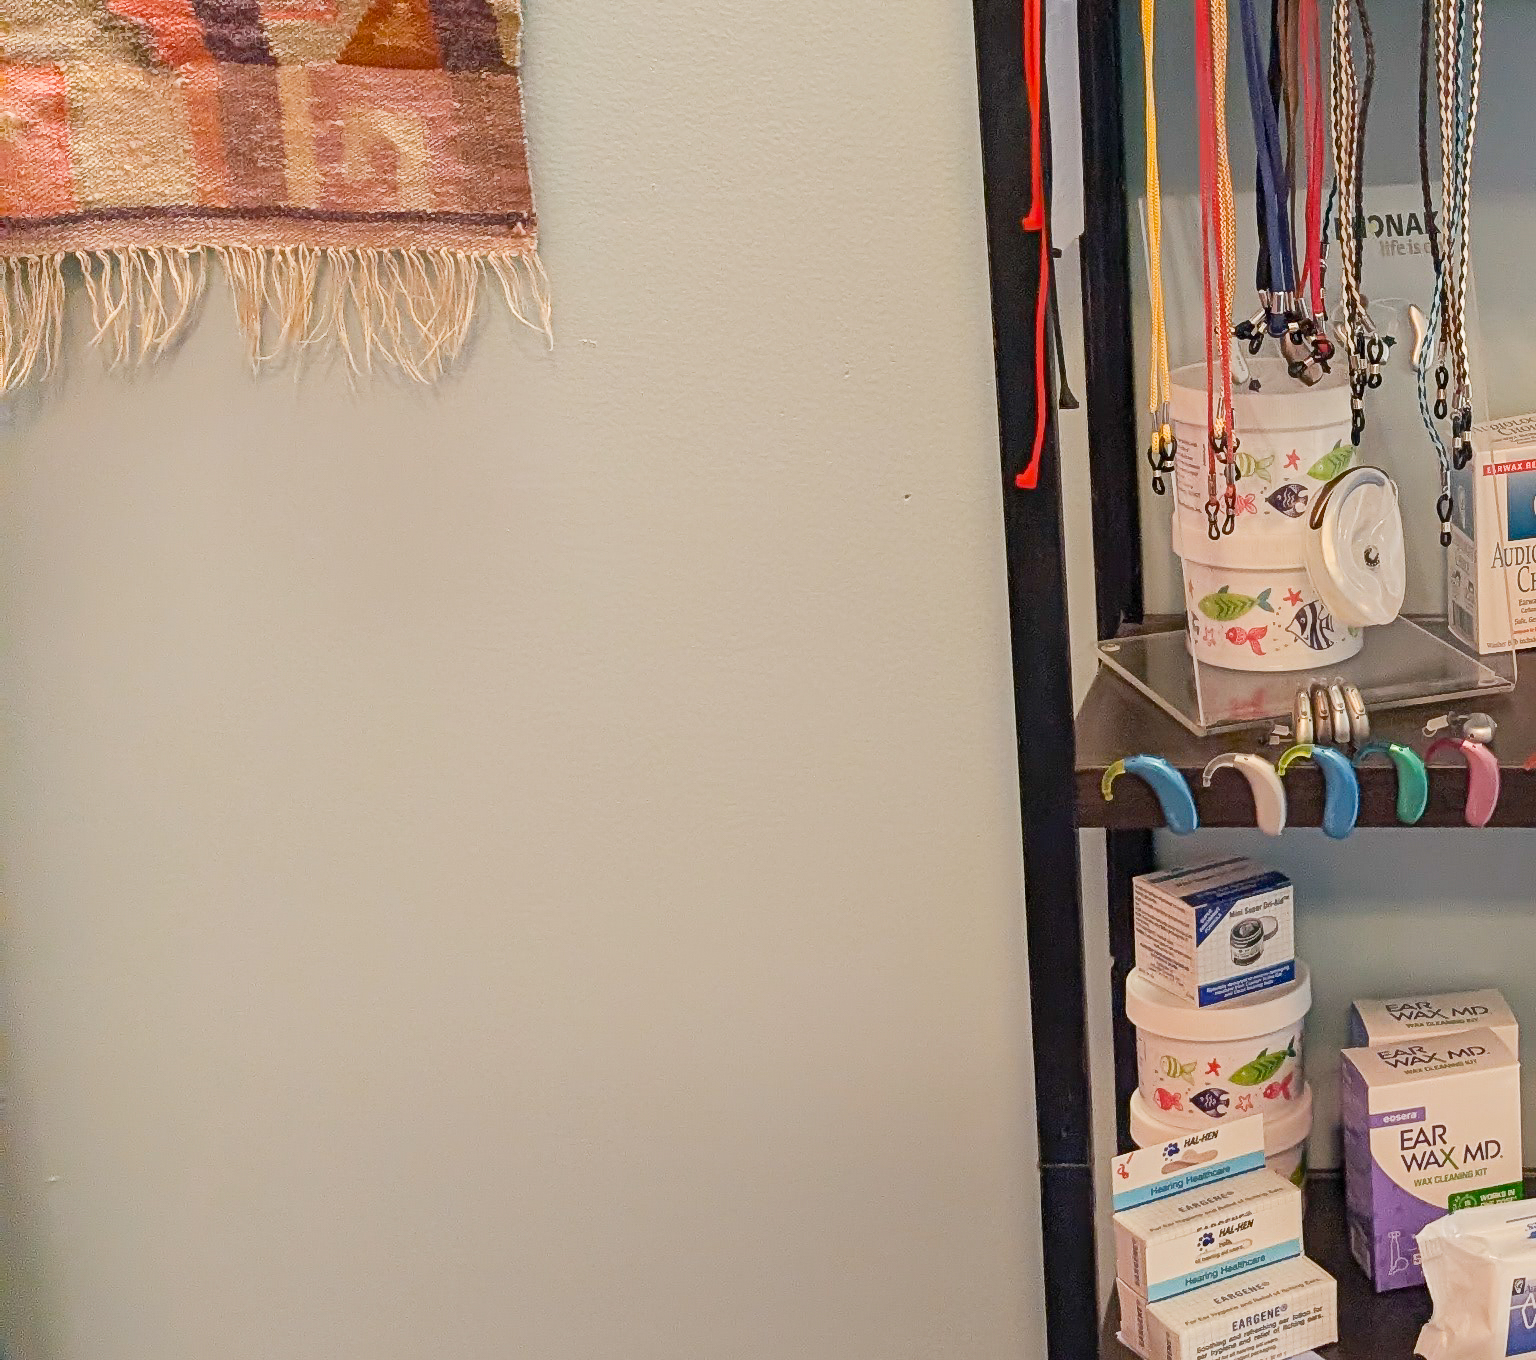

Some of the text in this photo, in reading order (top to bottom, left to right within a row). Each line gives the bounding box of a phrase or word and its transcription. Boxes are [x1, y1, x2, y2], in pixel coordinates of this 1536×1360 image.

[1385, 1001, 1431, 1013] EAR
[1388, 1008, 1449, 1022] WAX
[1377, 1045, 1427, 1060] EAR
[1385, 1052, 1447, 1069] WAX
[1183, 1129, 1219, 1148] HAL-HEN
[1400, 1124, 1448, 1151] EAR
[1400, 1146, 1459, 1173] WAX
[1150, 1165, 1231, 1196] Hearing Healthcare
[1413, 1167, 1488, 1187] WAX CLEANING KIT
[1218, 1218, 1255, 1238] HAL-HEN
[1185, 1253, 1266, 1286] Hearing Healthcare
[1228, 1332, 1242, 1343] and
